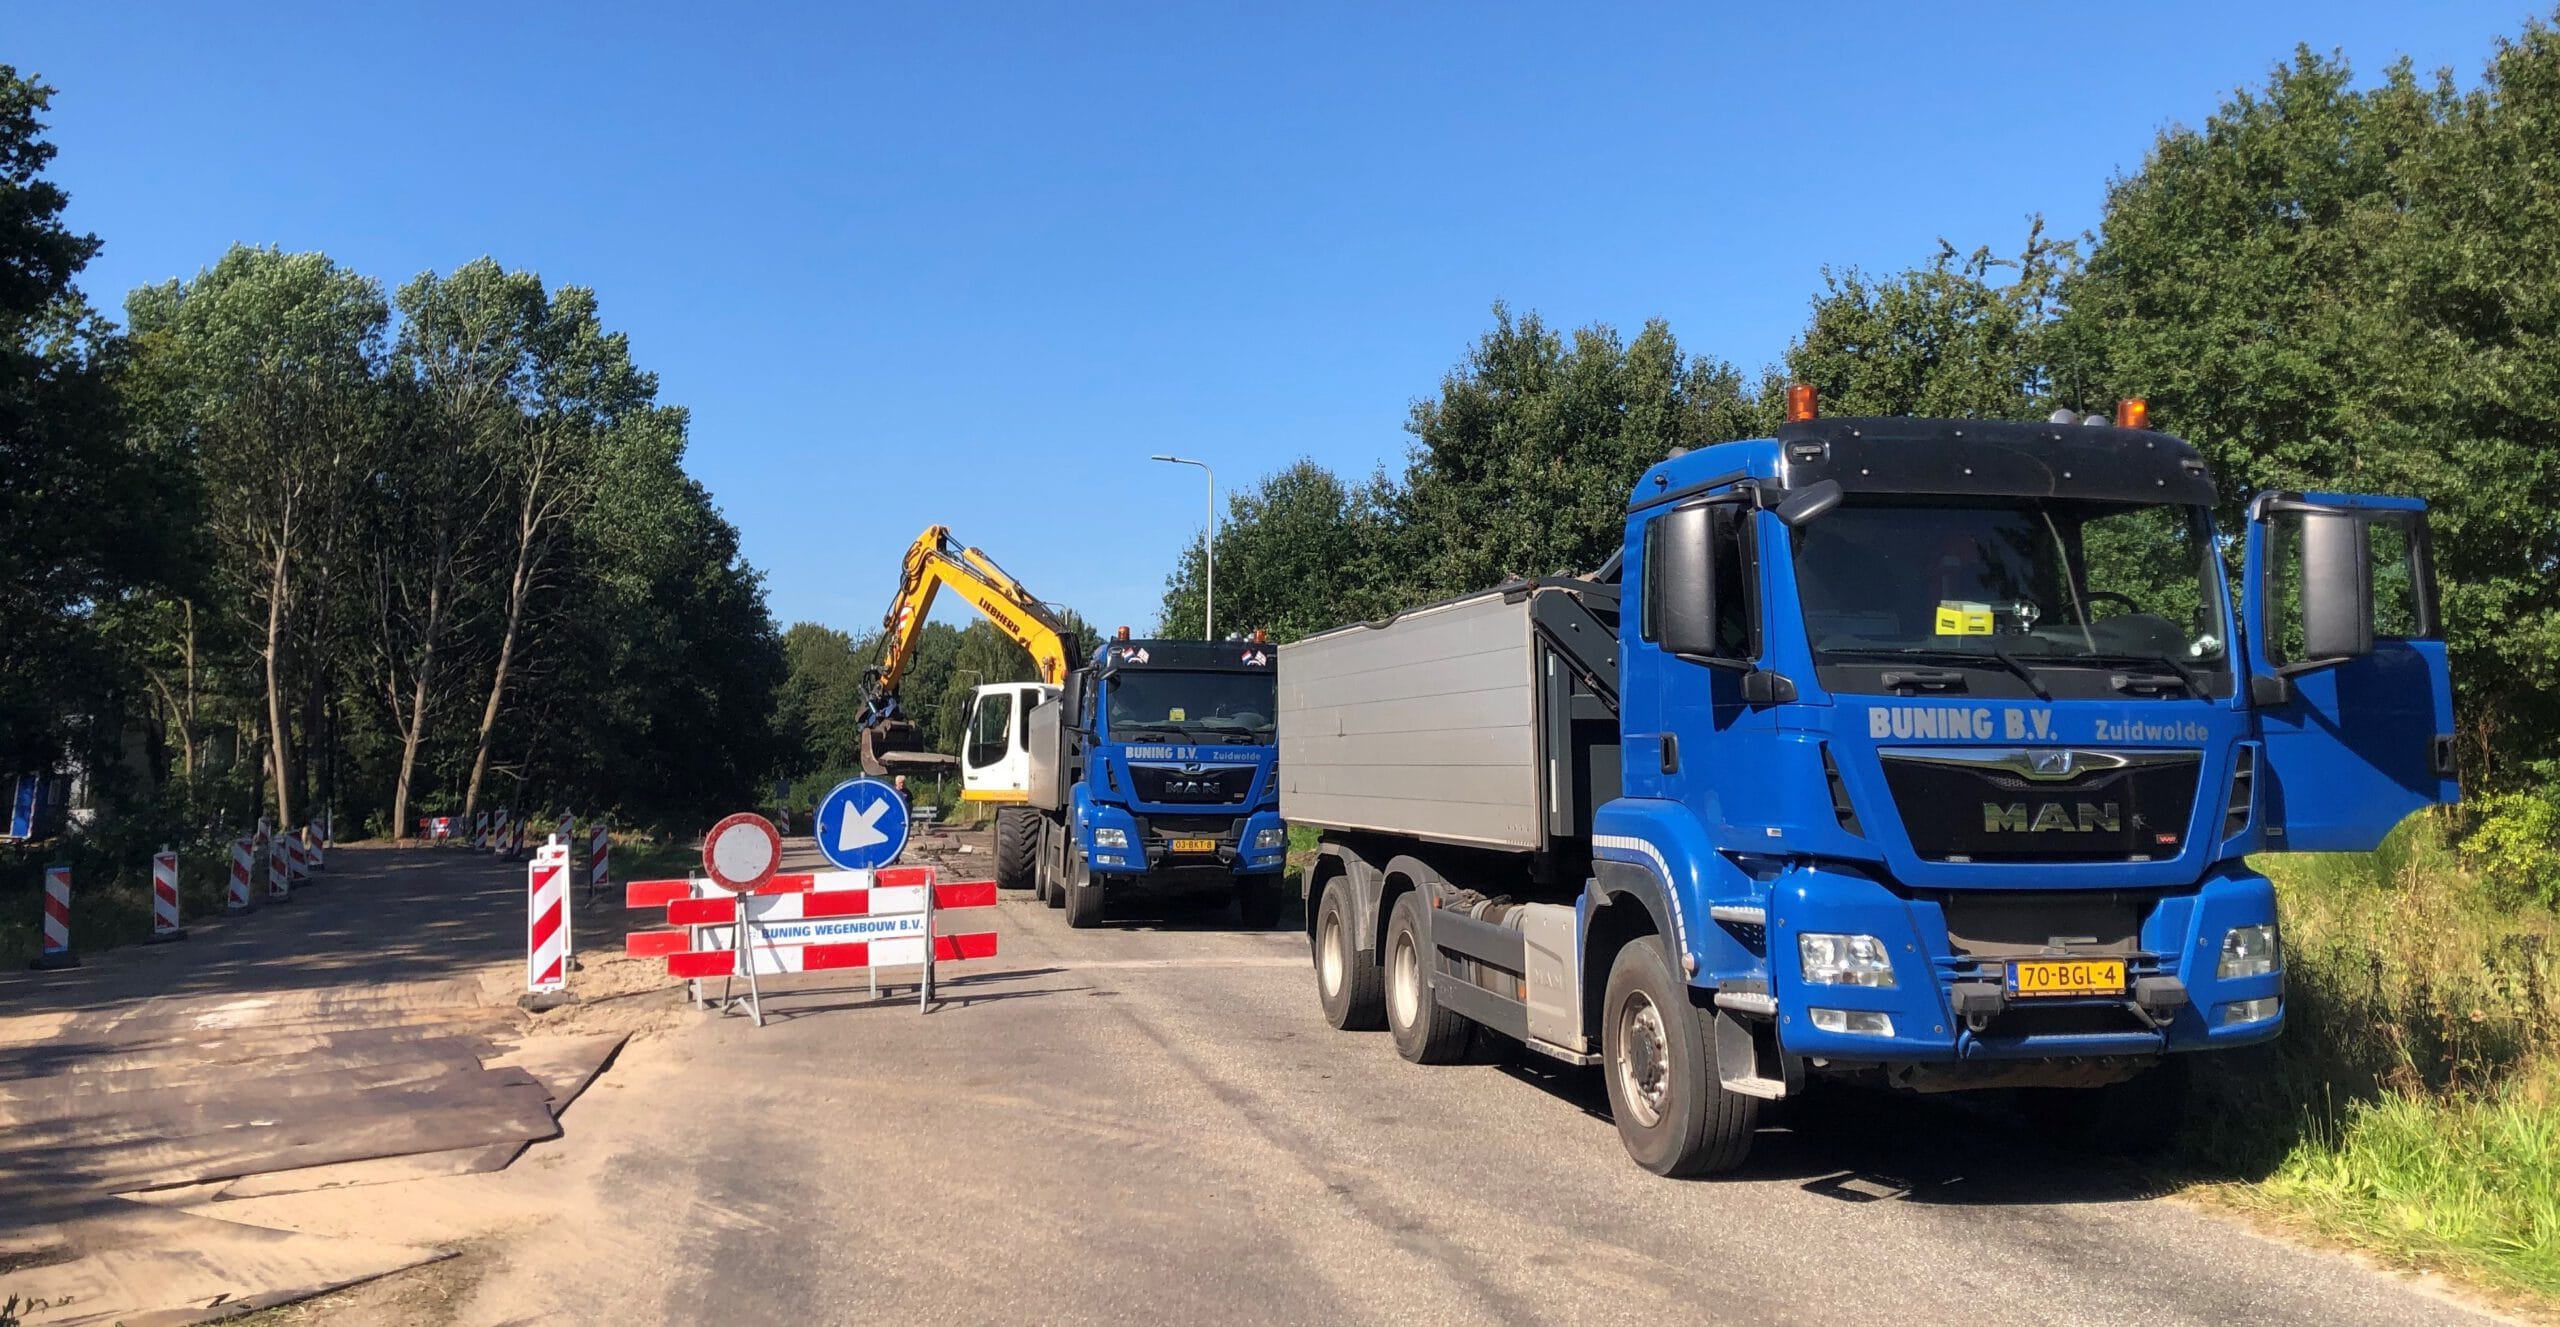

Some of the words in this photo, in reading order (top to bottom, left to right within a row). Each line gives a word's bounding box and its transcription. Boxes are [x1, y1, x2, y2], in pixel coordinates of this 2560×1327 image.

[979, 597, 1020, 635] LIEBHERR
[1869, 707, 1993, 739] BUNING
[2005, 709, 2058, 741] B.V.
[2096, 720, 2208, 741] Zuidwolde
[1126, 747, 1173, 759] BUNING
[1177, 748, 1198, 760] B.V.
[1213, 752, 1261, 760] Zuidwolde
[1166, 782, 1220, 794] MAN
[1983, 803, 2120, 832] MAN
[762, 926, 811, 939] BUNING
[815, 921, 896, 935] WEGENBOUW
[900, 919, 923, 931] B.V.
[2025, 965, 2116, 987] 70-BGL-4
